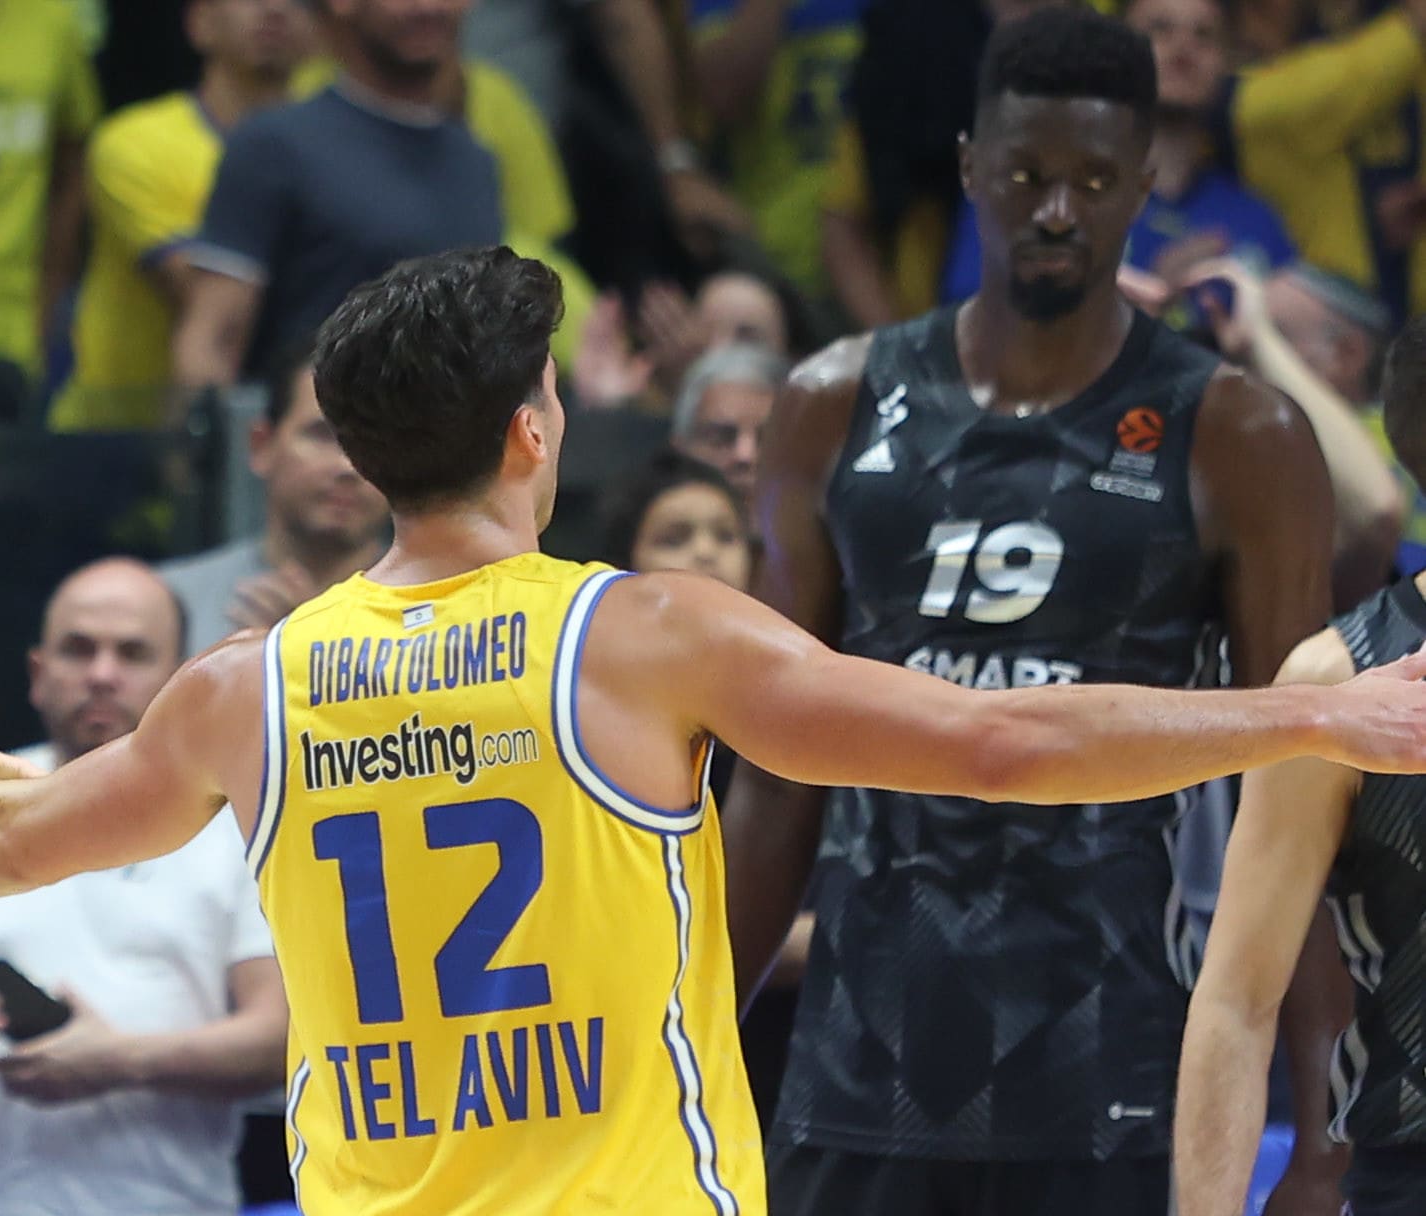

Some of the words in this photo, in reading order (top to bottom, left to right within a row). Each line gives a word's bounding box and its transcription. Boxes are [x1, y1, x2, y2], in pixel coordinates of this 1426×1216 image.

[918, 519, 1066, 624] 19
[310, 611, 527, 708] DIBARTOLOMEO
[300, 713, 539, 790] Investing.com
[312, 797, 552, 1025] 12
[325, 1041, 436, 1142] TEL
[452, 1017, 605, 1132] AVIV
